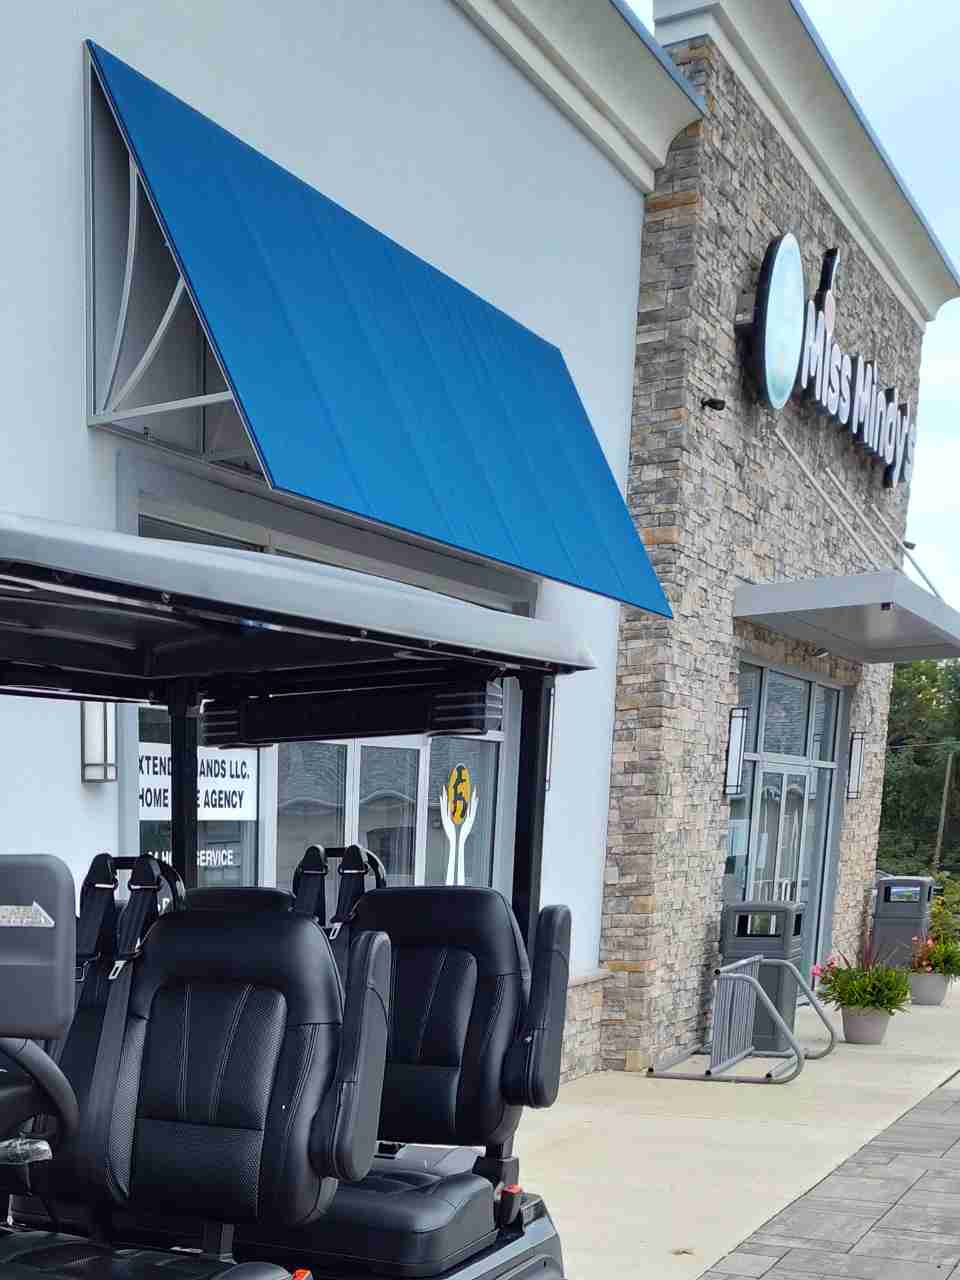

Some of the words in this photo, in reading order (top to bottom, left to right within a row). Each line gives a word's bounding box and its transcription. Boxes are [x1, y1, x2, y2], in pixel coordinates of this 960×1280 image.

[801, 294, 852, 425] Miss
[138, 755, 172, 776] XTEND
[200, 759, 227, 778] ANDS
[203, 789, 245, 808] AGENCY
